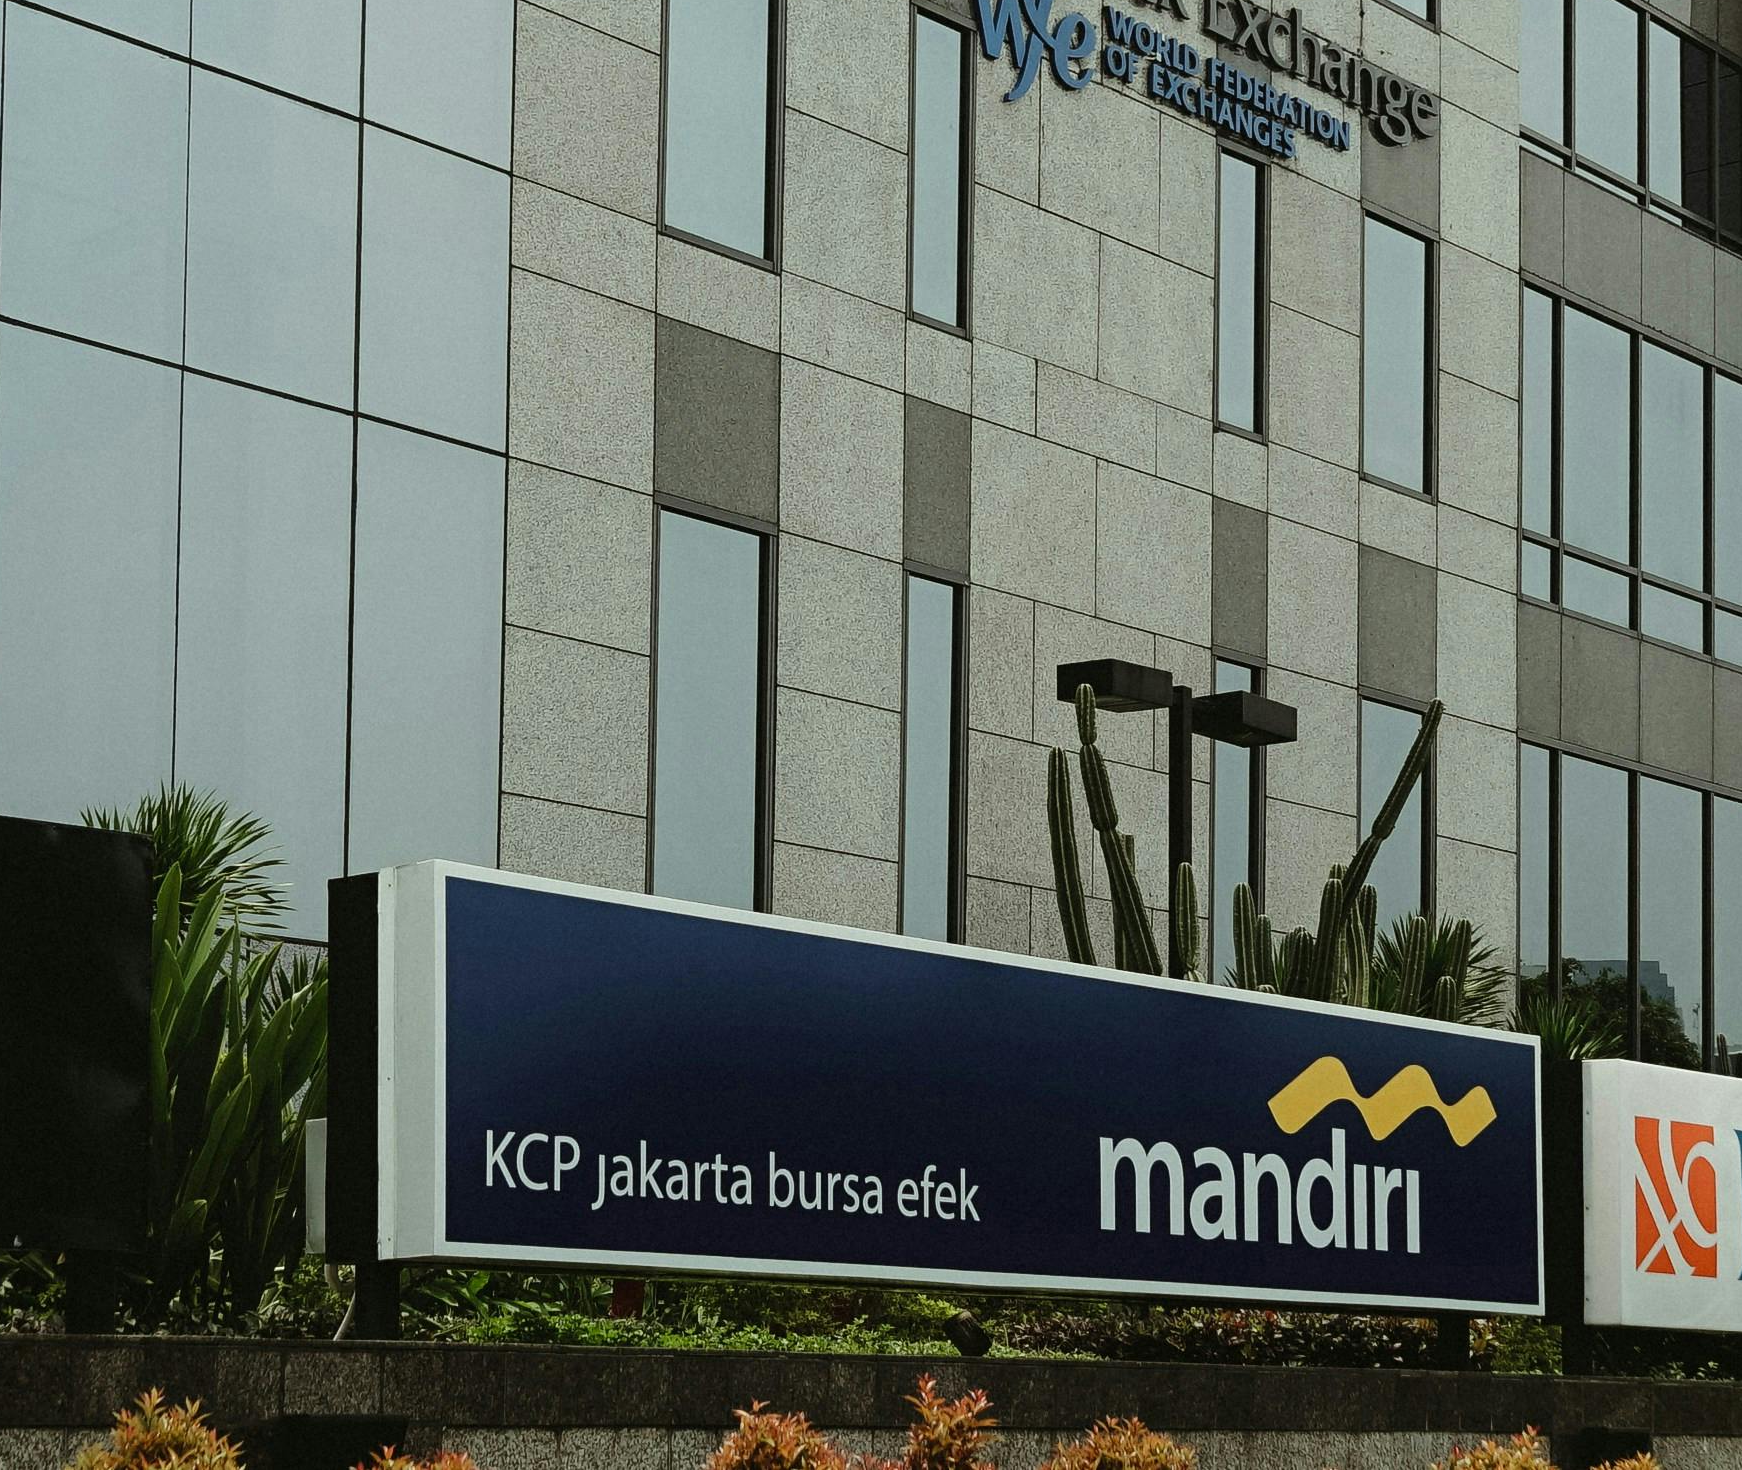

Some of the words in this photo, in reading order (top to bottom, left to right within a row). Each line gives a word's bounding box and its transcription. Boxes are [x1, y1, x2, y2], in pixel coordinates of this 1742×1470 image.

[1104, 5, 1201, 76] WORLD
[1207, 58, 1352, 151] FEDERATION
[1106, 44, 1139, 83] OF
[1149, 63, 1297, 159] EXCHANGES
[485, 1129, 581, 1192] KCP
[769, 1151, 884, 1215] bursa
[896, 1164, 981, 1222] efek
[1099, 1127, 1420, 1253] mandiri
